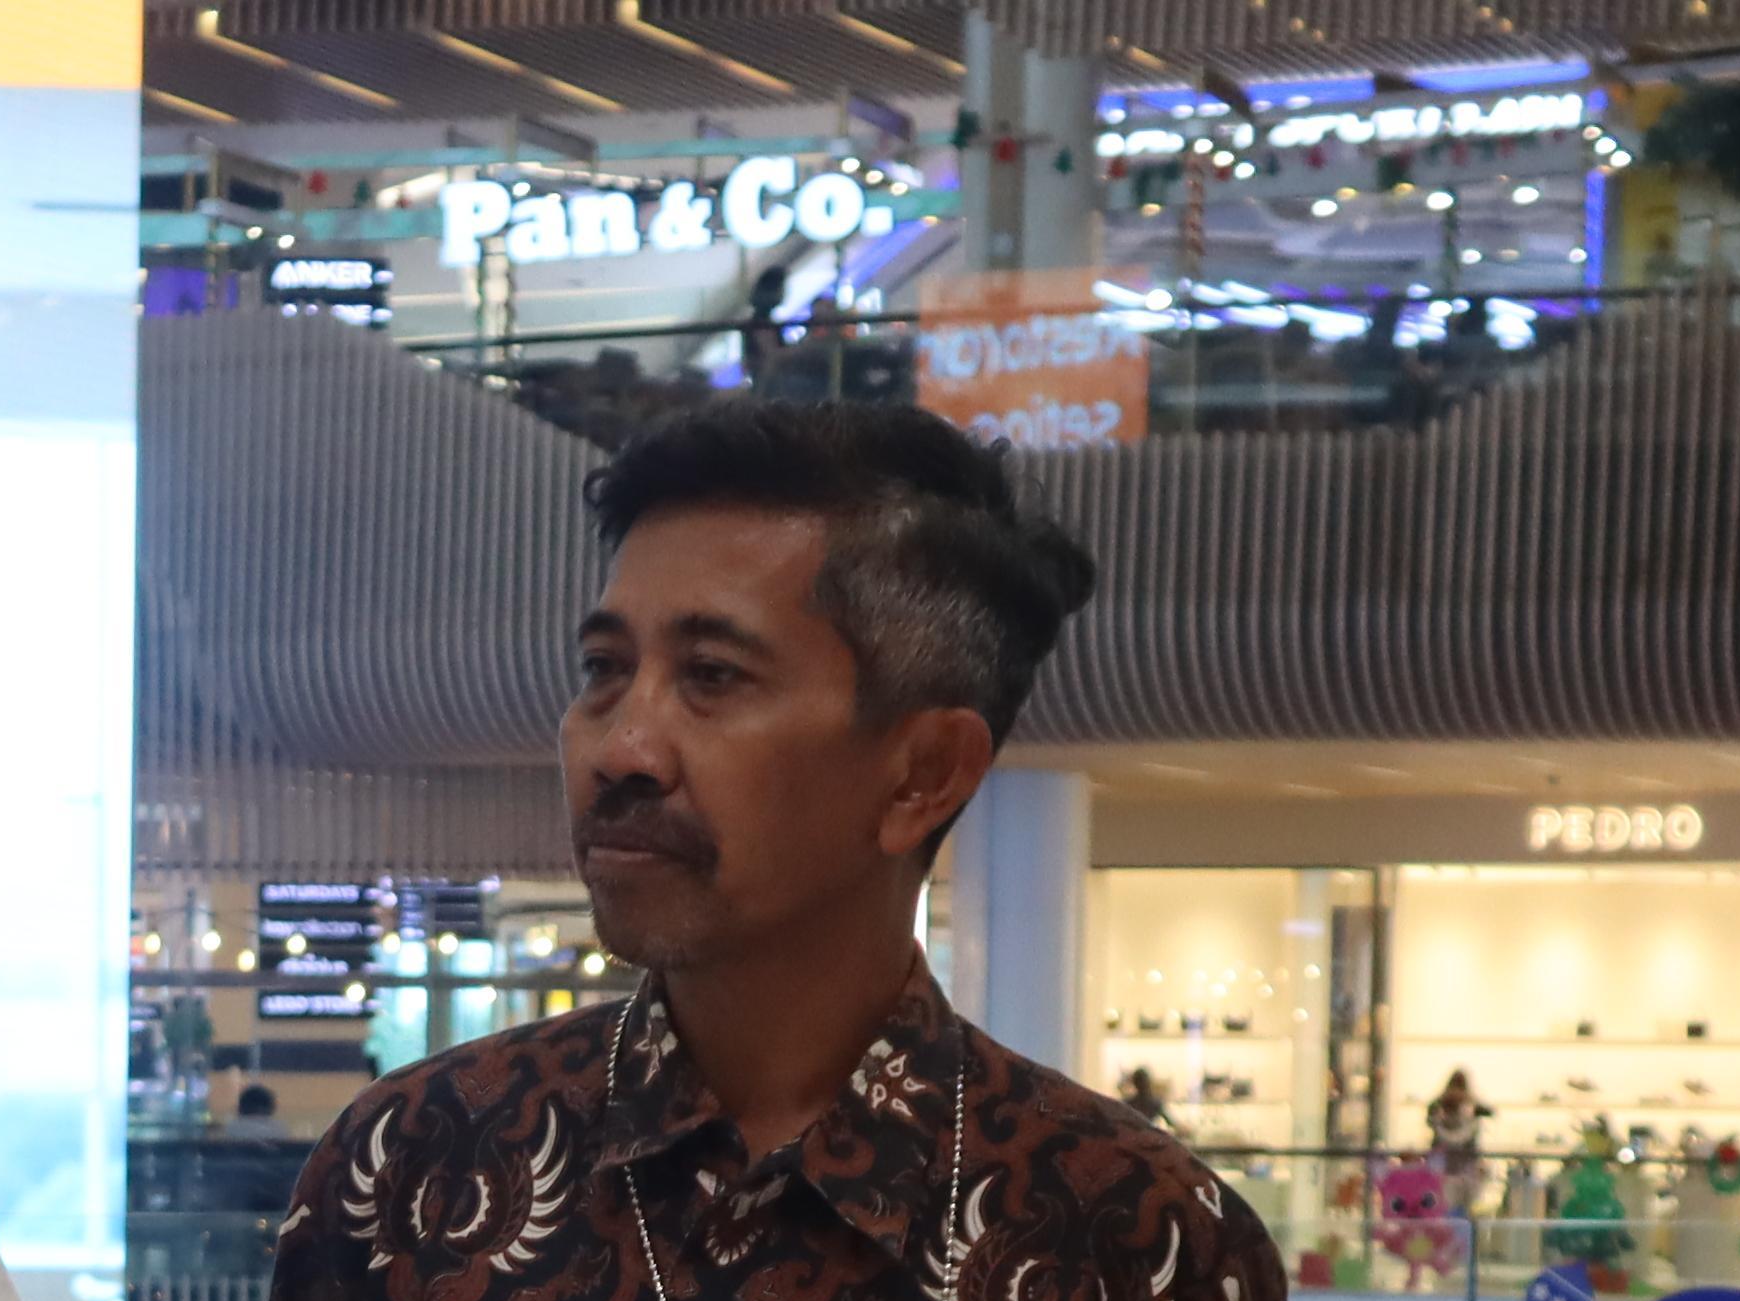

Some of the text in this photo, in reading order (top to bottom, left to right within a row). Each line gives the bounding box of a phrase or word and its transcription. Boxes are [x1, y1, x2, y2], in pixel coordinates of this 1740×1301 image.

[438, 154, 895, 268] Pan & Co.
[1528, 804, 1703, 851] PEDRO
